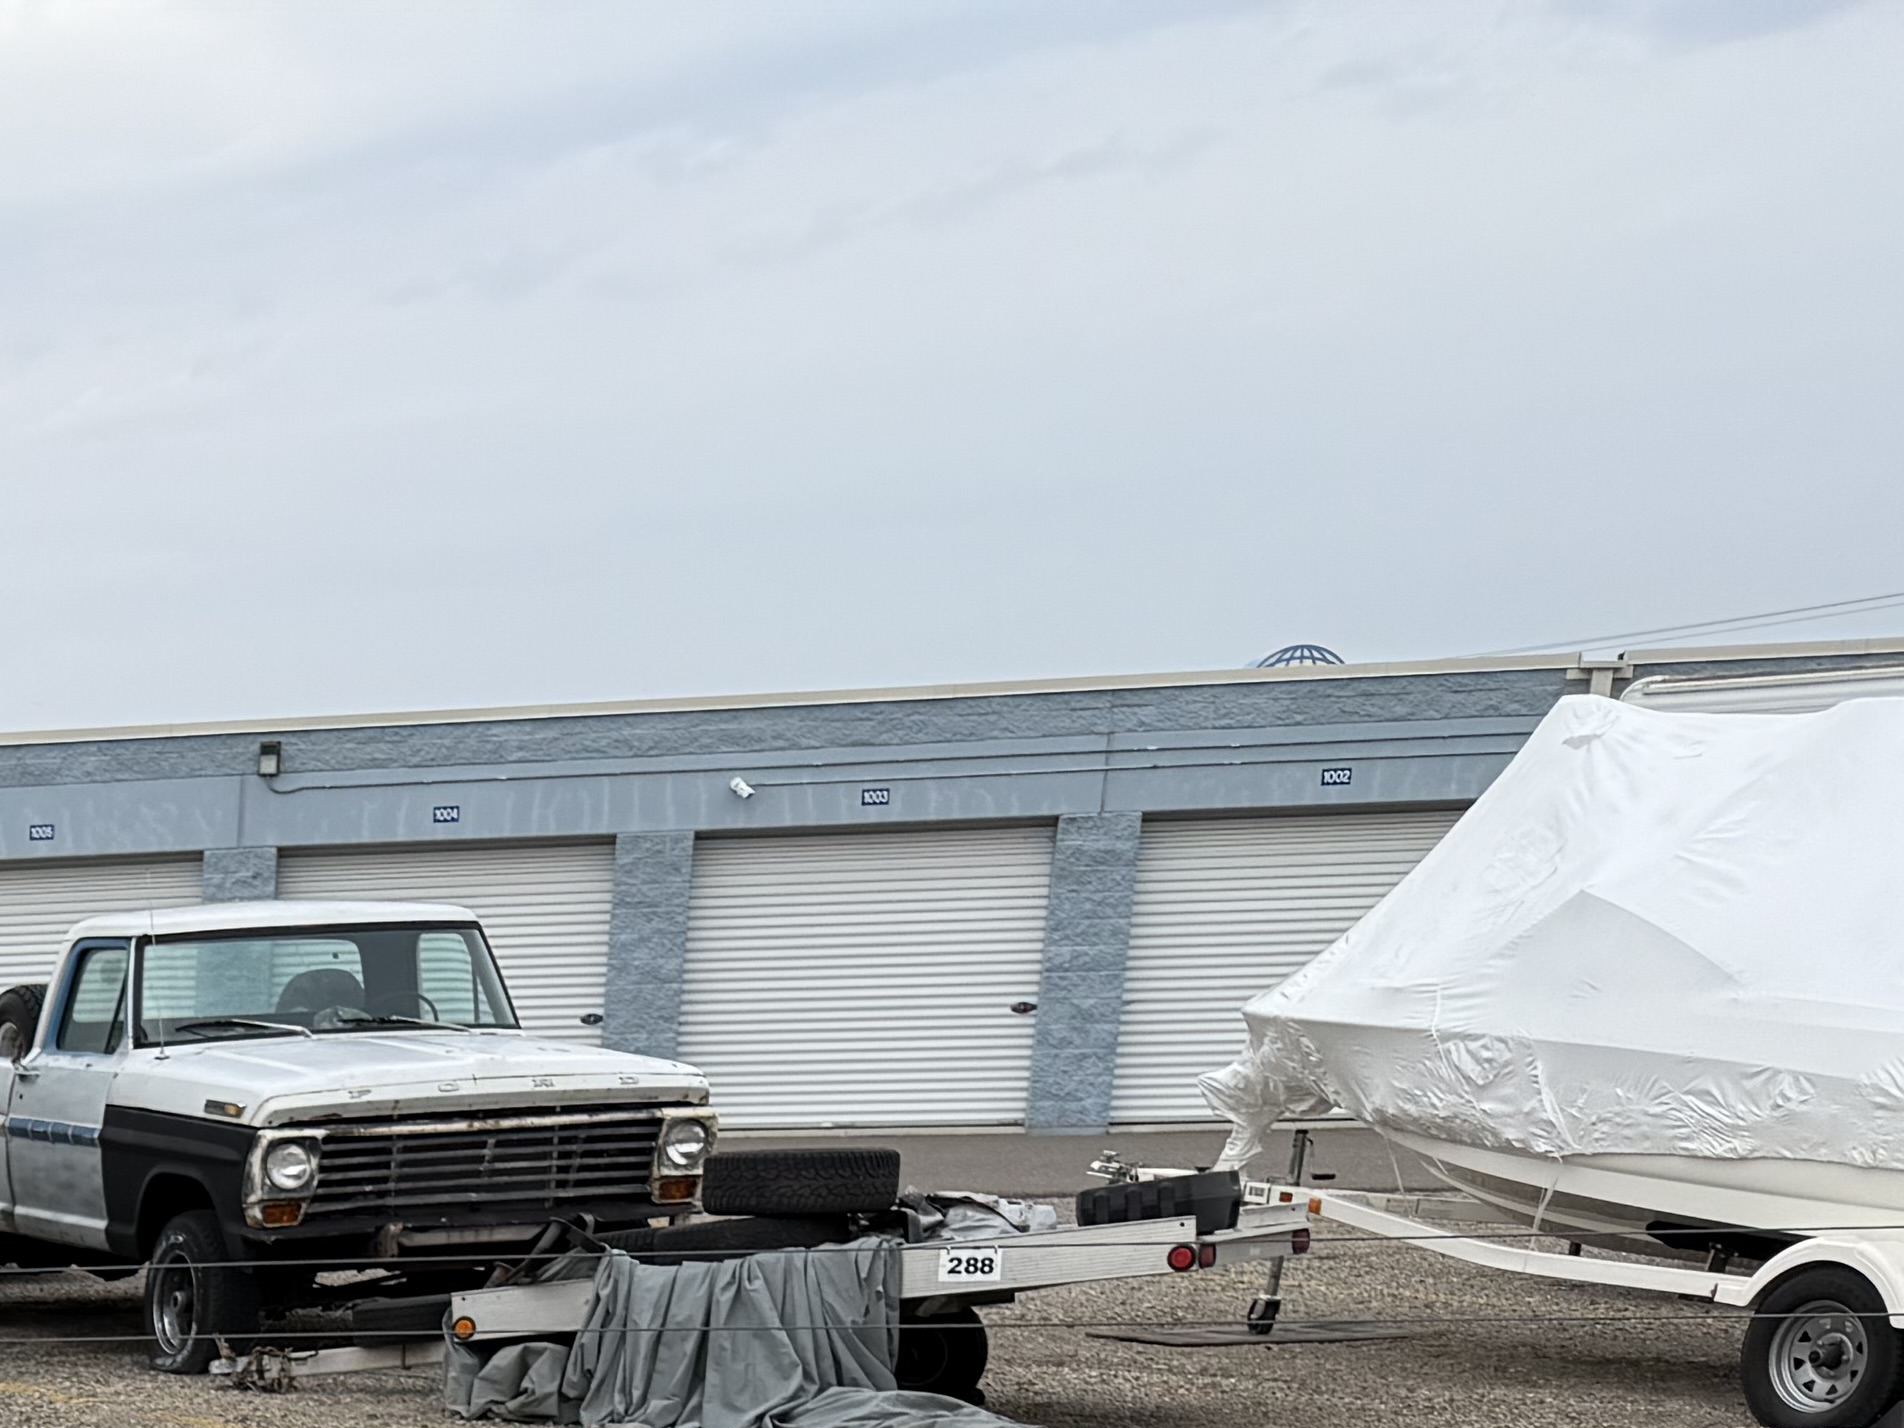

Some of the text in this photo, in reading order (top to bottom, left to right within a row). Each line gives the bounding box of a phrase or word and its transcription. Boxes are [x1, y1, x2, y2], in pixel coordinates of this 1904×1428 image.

[1323, 769, 1351, 784] 1002
[863, 790, 889, 804] 1003
[947, 1256, 995, 1275] 288
